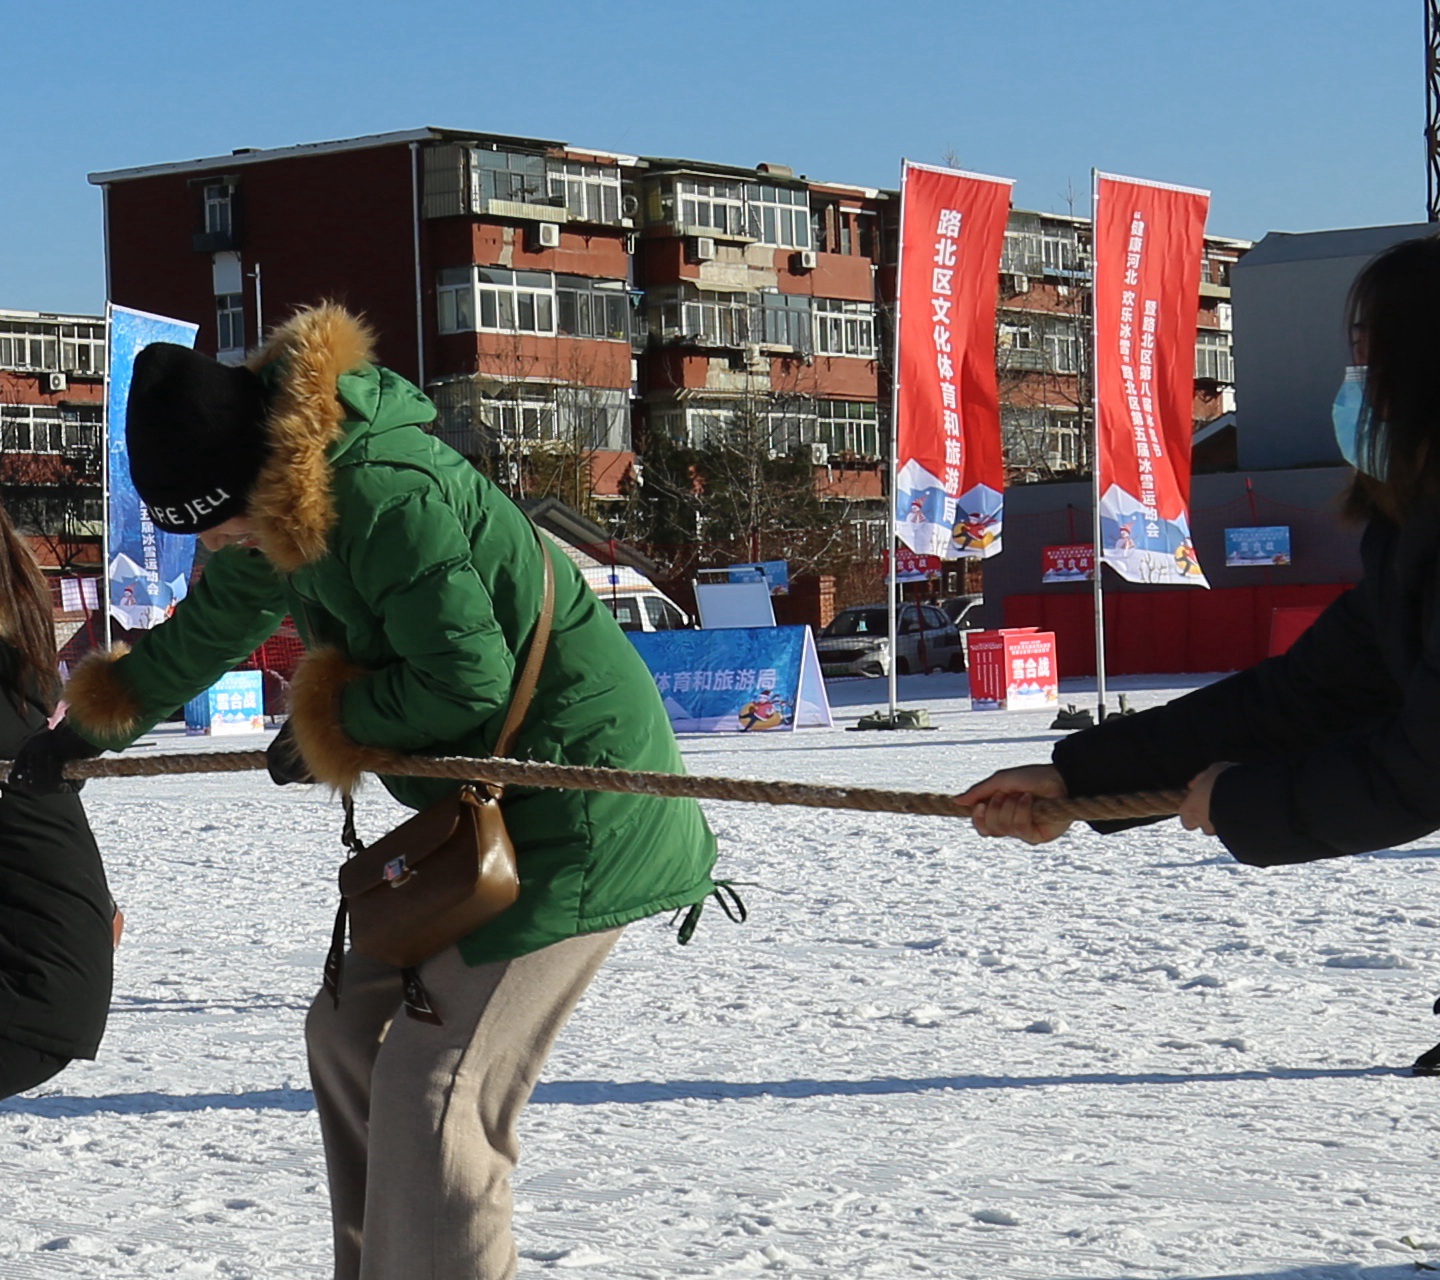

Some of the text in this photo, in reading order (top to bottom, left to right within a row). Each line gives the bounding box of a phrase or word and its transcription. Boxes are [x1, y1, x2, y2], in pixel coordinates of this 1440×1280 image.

[931, 208, 964, 525] 路北区文化体育和旅游局
[1139, 299, 1162, 458] 暨路北区第八届冰雪节
[216, 691, 257, 711] 雪合战
[1012, 656, 1051, 680] 雪合战
